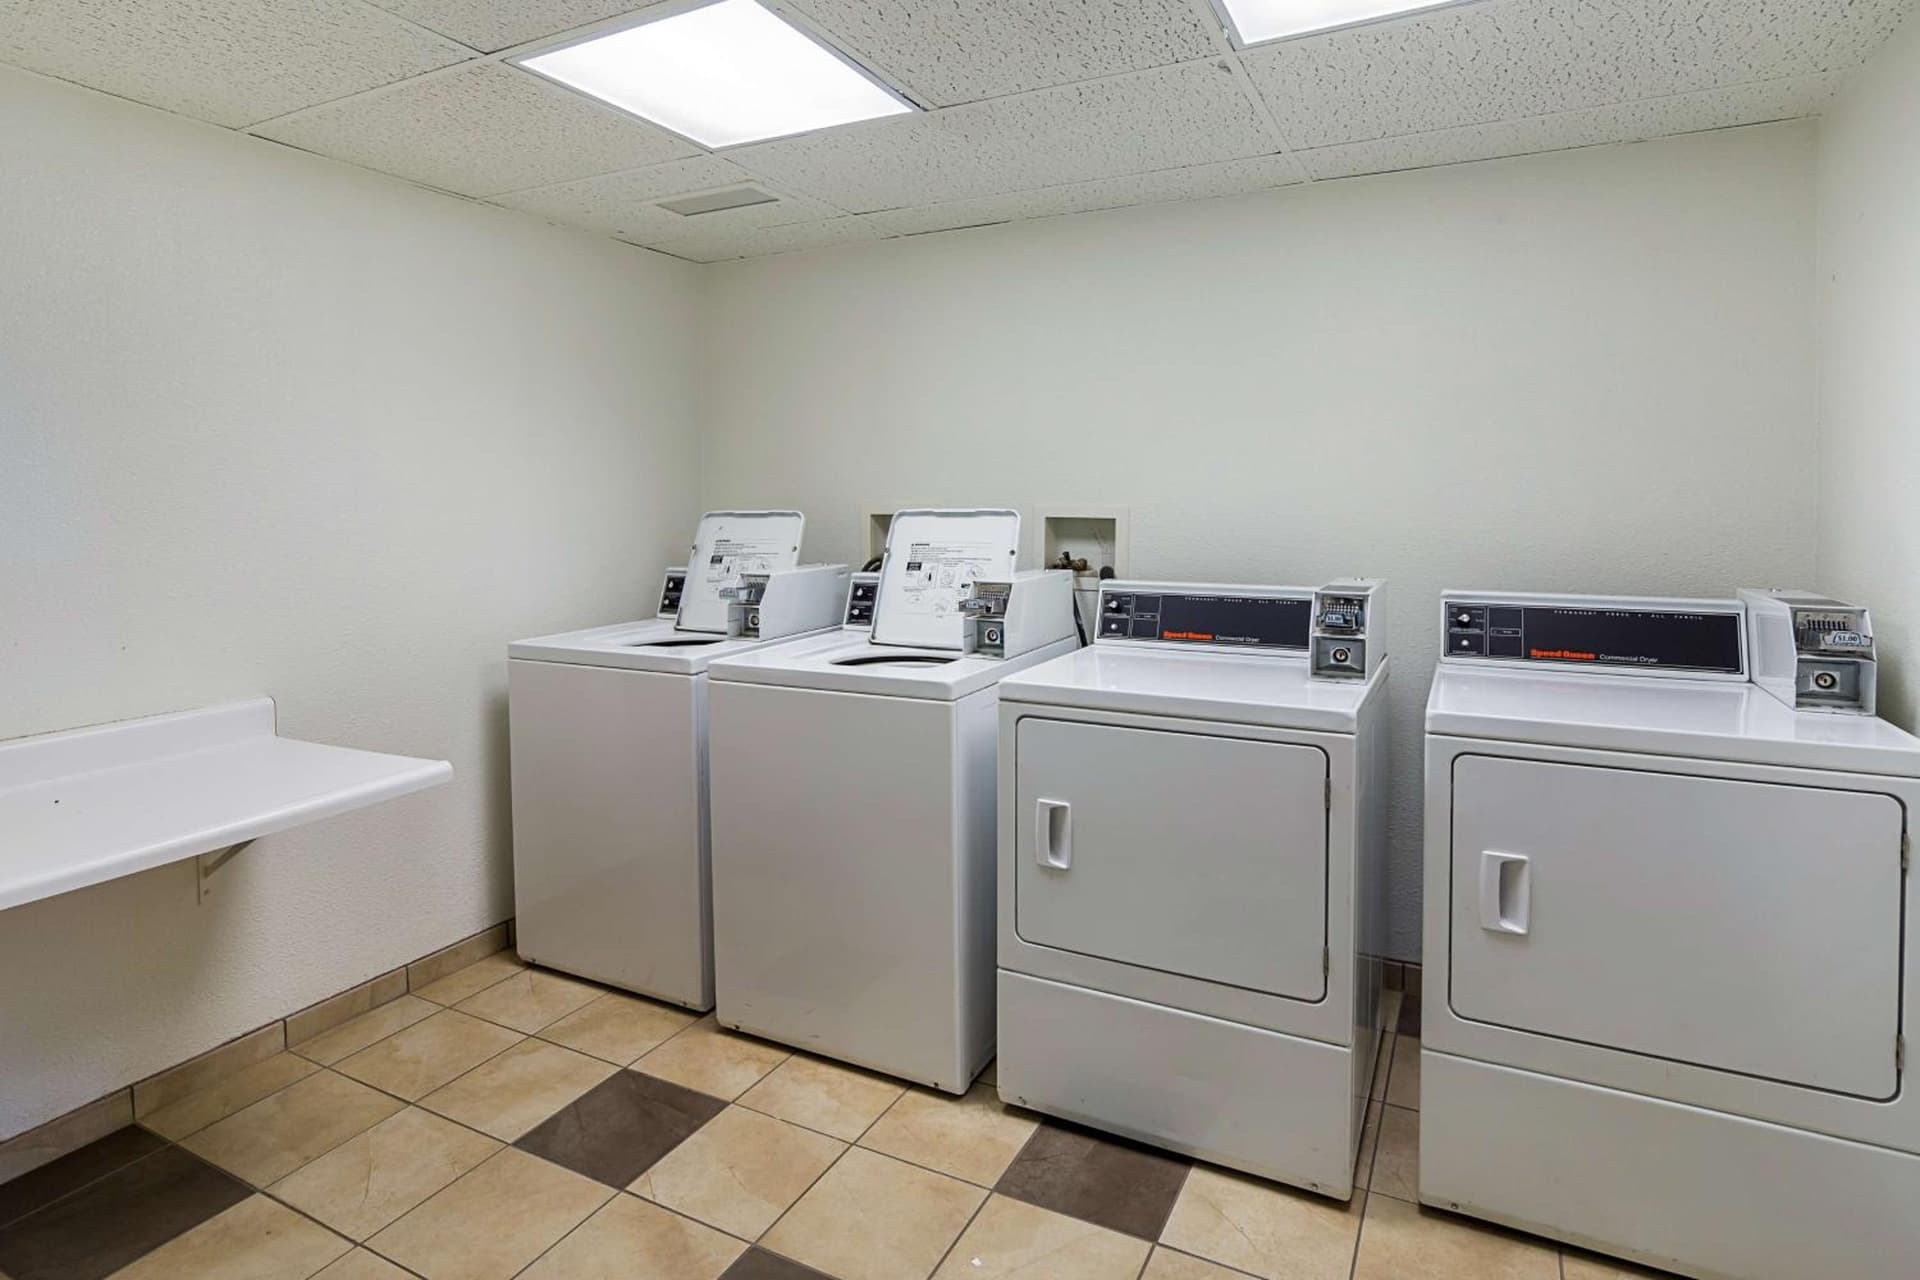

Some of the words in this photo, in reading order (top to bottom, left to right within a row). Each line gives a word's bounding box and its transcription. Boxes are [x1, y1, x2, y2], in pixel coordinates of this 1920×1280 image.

[1163, 630, 1188, 639] Speed
[1188, 632, 1213, 640] Queen
[1215, 634, 1244, 642] Commercial
[1246, 636, 1260, 644] Dryer
[1531, 648, 1562, 658] Speed
[1563, 650, 1595, 659] Queen
[1600, 653, 1638, 662] Commercial
